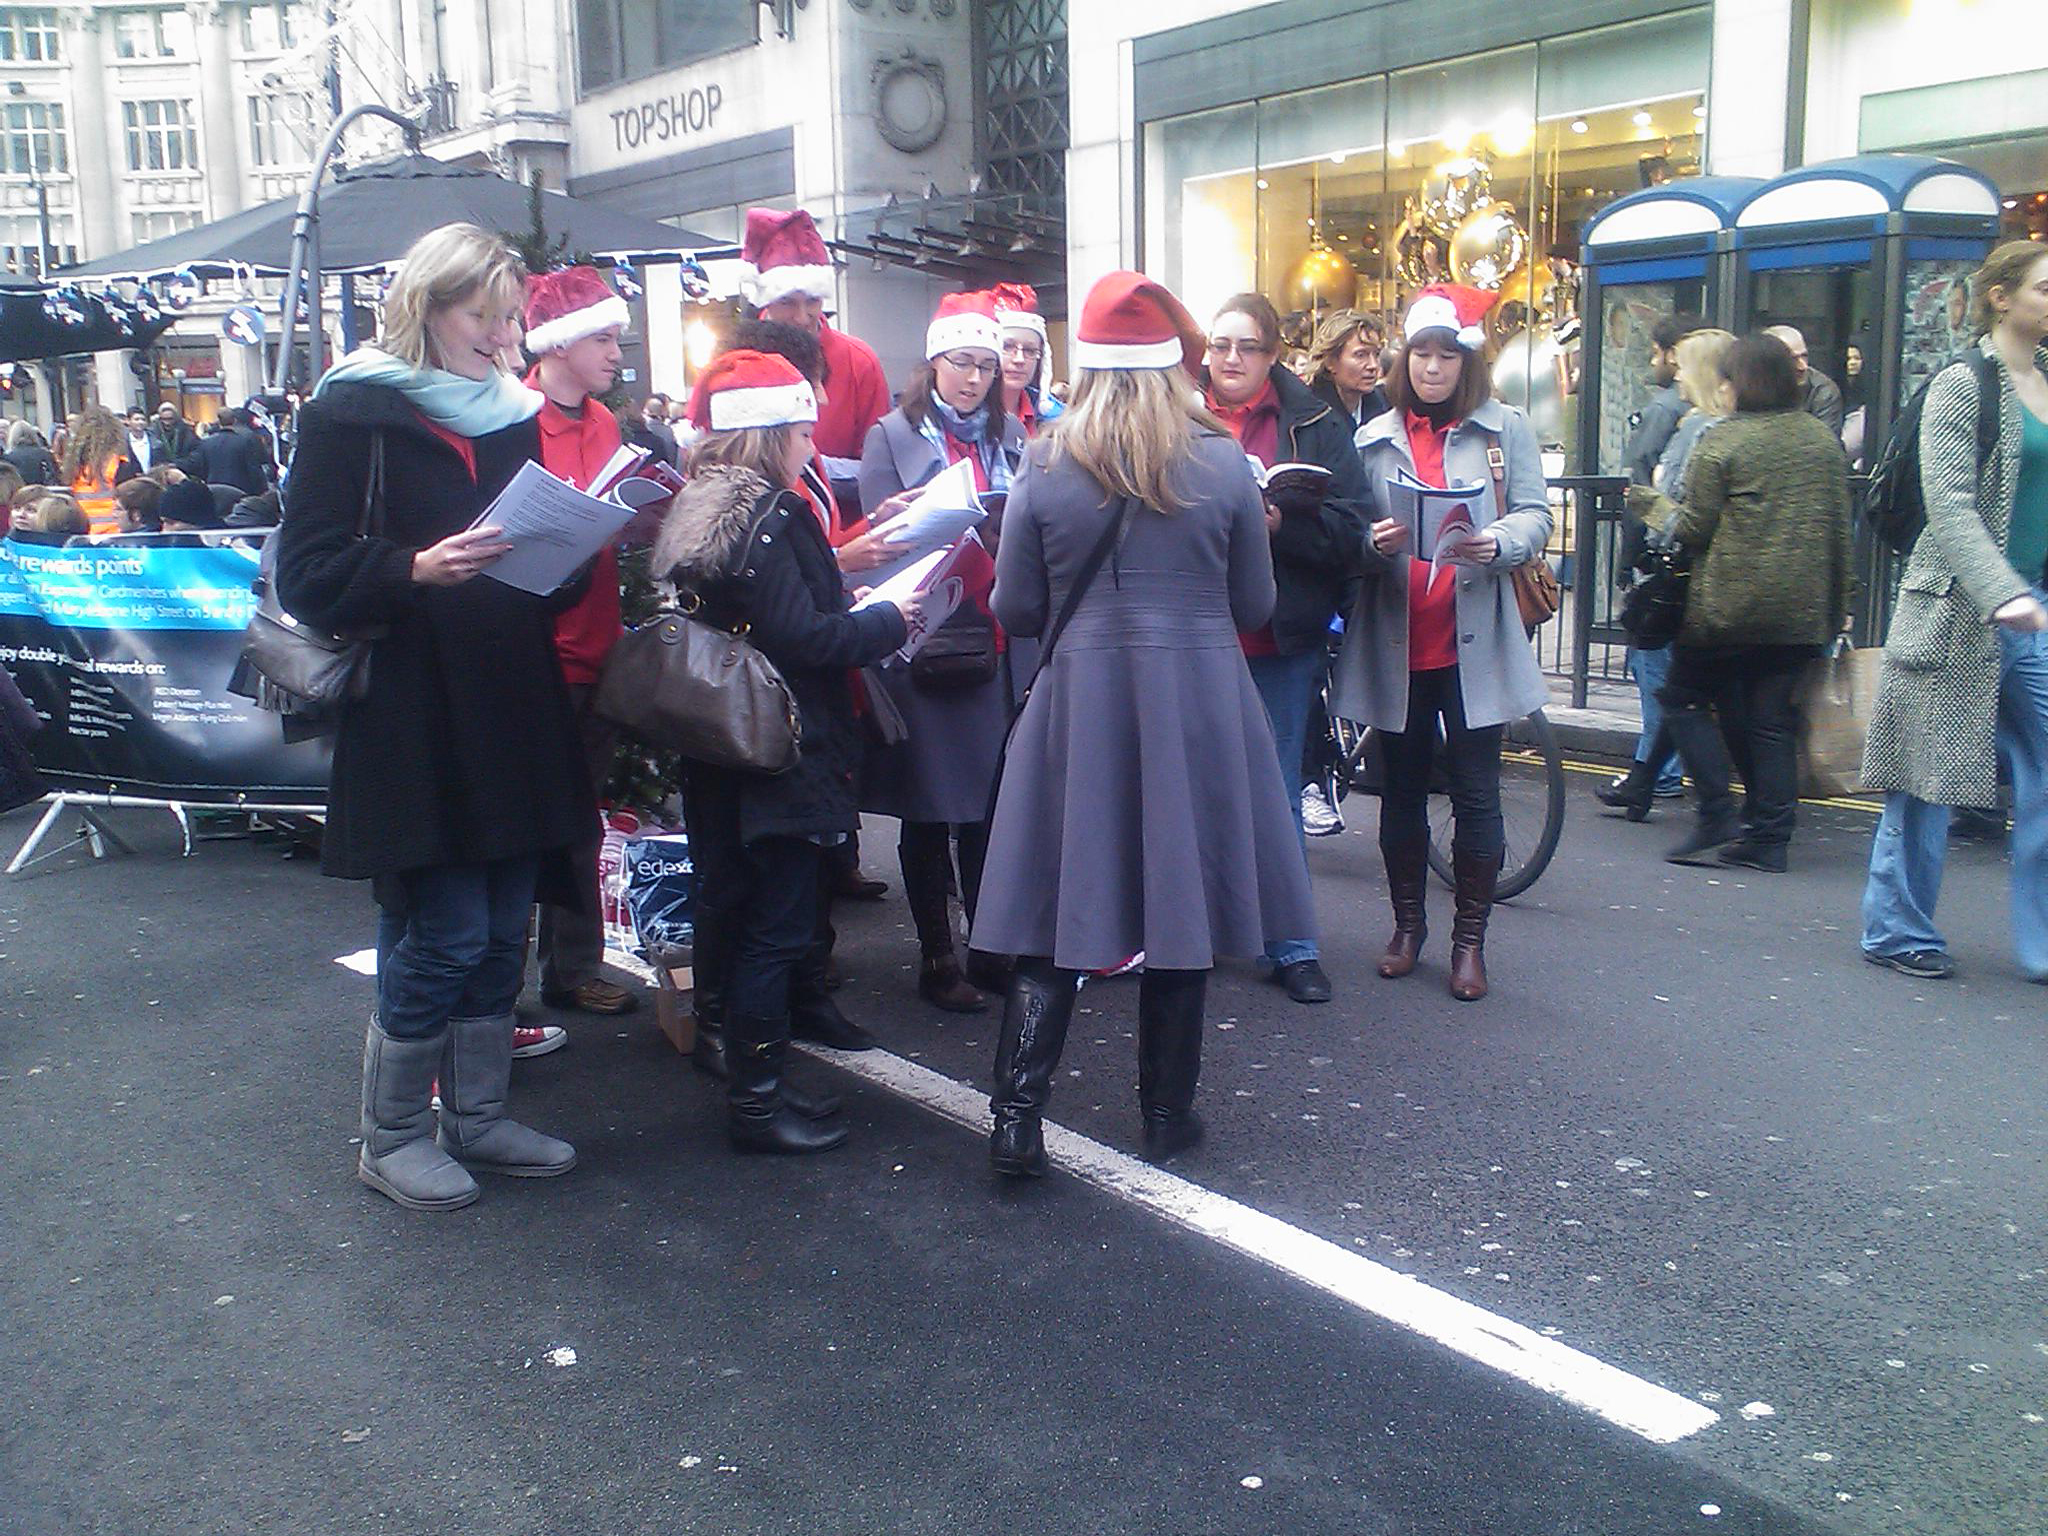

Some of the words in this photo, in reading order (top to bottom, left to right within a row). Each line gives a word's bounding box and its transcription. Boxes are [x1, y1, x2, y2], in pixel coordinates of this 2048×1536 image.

[609, 83, 722, 151] TOPSHOP
[19, 553, 95, 576] rewards
[96, 554, 144, 580] points
[18, 645, 57, 662] double
[95, 660, 145, 675] rewards
